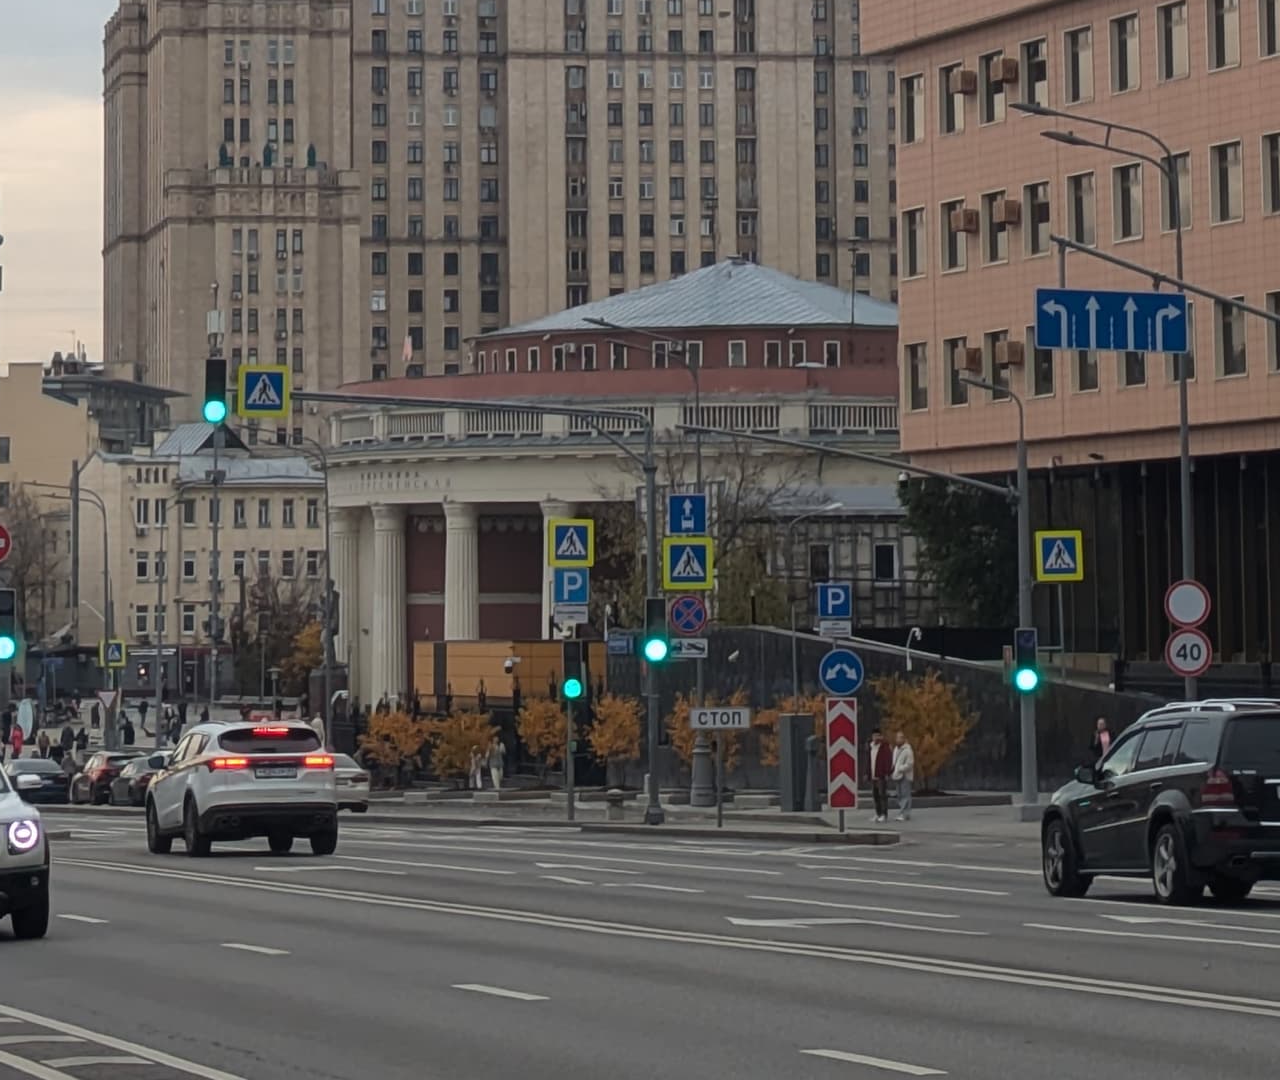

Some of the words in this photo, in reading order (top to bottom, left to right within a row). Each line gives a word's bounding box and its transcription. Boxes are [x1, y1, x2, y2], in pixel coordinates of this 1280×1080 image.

[563, 572, 582, 600] P
[828, 588, 845, 614] P
[1176, 643, 1202, 661] 40
[697, 711, 742, 726] СТОП
